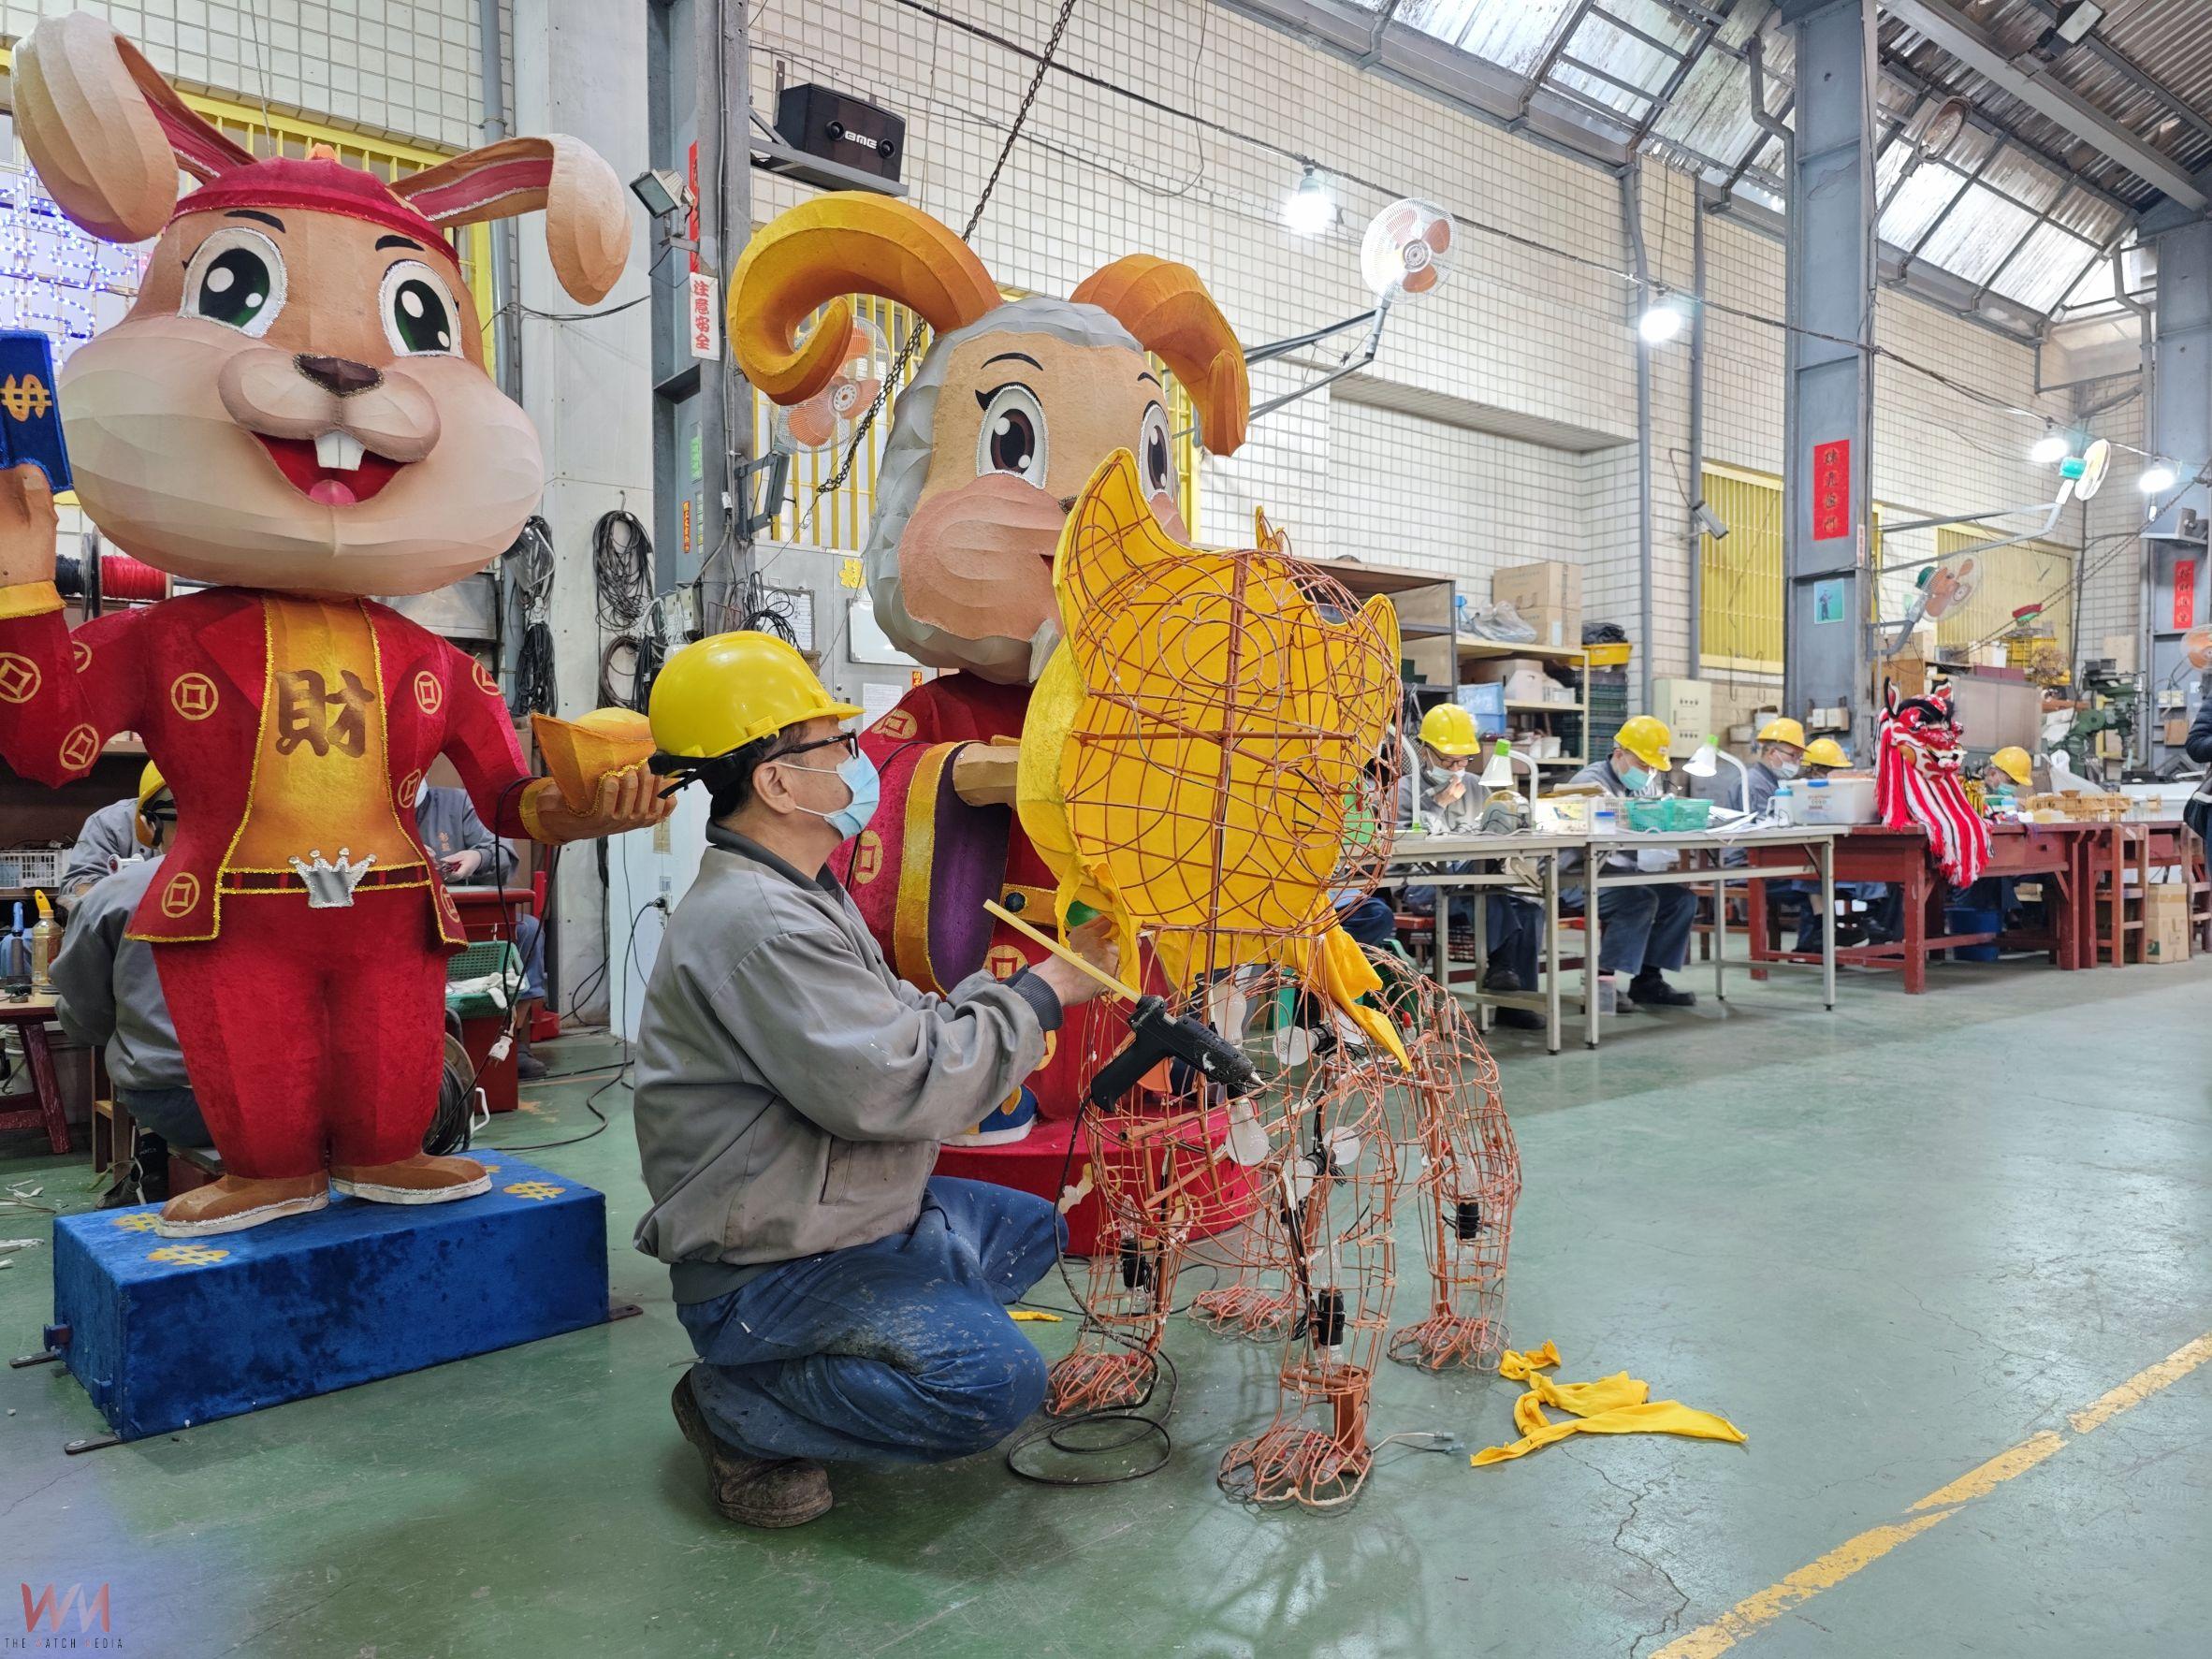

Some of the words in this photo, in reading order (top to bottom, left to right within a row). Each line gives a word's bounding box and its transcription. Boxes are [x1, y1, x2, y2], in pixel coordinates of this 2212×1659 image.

[694, 280, 710, 351] 注意安全
[275, 669, 374, 758] 財
